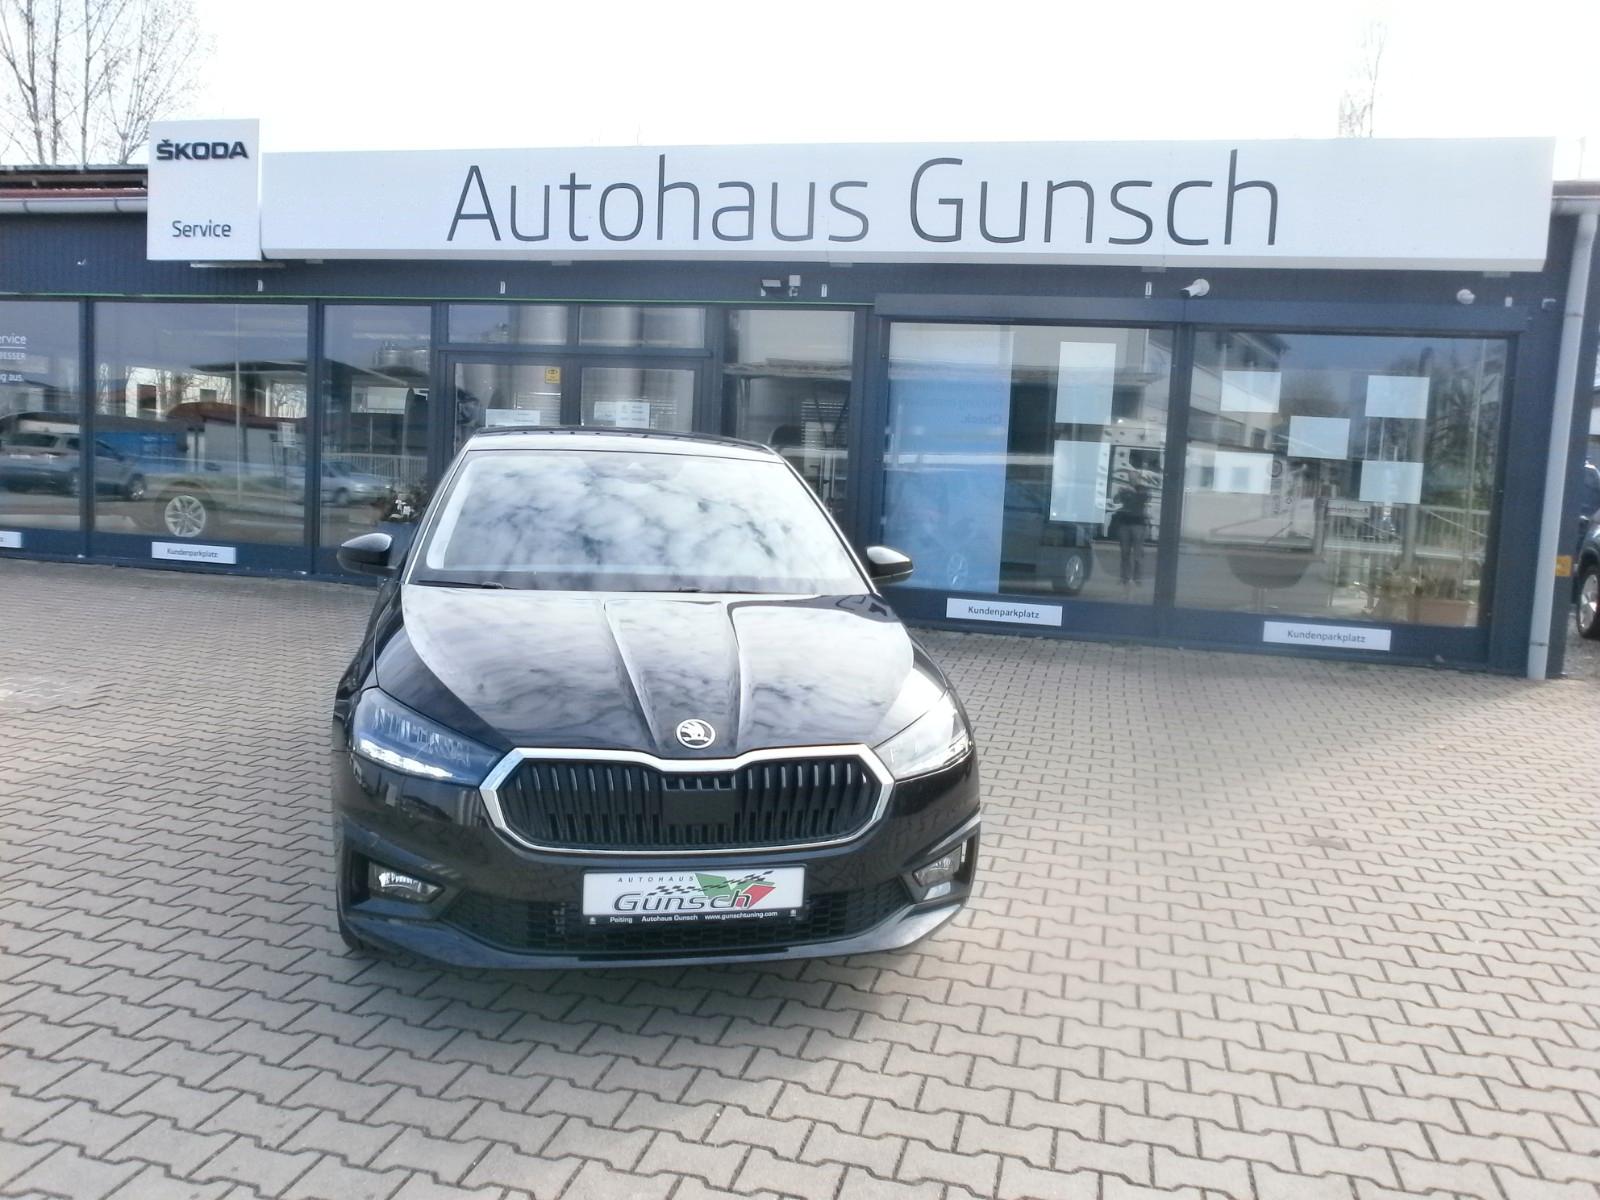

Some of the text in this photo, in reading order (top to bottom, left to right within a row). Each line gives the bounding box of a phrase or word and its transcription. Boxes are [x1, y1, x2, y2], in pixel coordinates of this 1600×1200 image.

[156, 139, 248, 160] ŠKODA
[446, 148, 1280, 247] Autohaus Gunsch
[171, 219, 232, 238] Service
[167, 547, 219, 560] Kundenparkplatz
[967, 605, 1040, 620] Kundenparkplatz
[1287, 629, 1366, 644] Kundenparkplatz
[617, 875, 695, 884] AUTOHAUS
[613, 889, 753, 912] Gunsch
[641, 915, 673, 923] Autohaus
[673, 914, 698, 922] Gunsch
